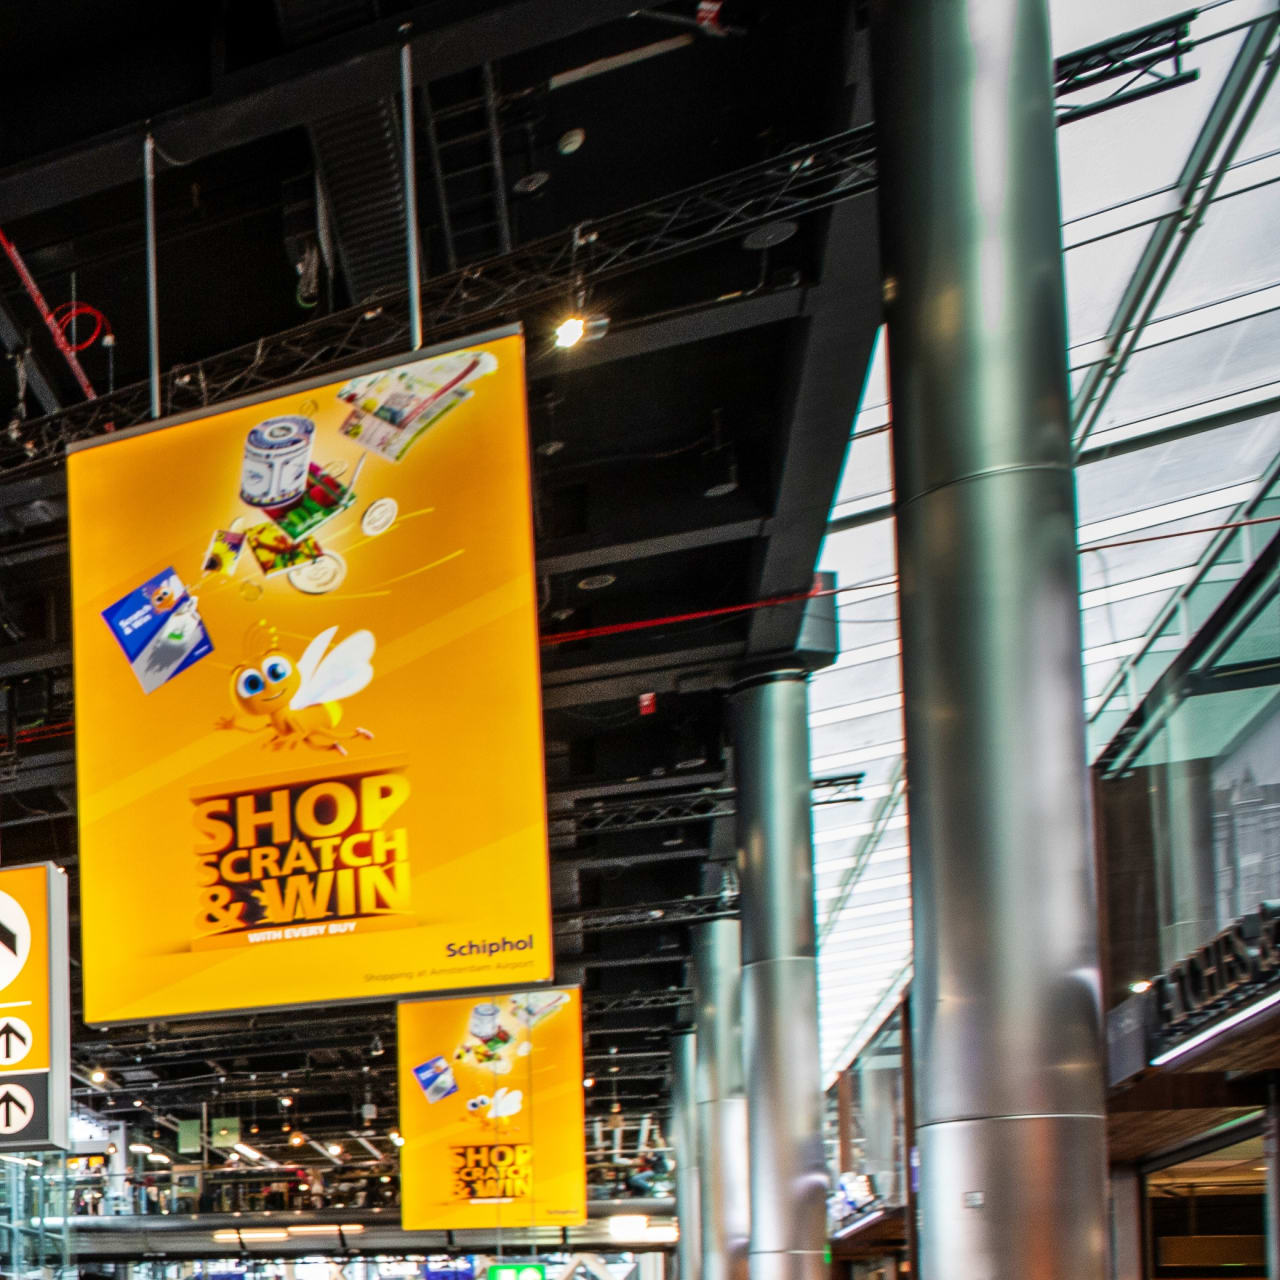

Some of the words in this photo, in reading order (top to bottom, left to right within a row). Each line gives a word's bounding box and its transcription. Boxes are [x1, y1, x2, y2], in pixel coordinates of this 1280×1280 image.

[192, 773, 411, 855] SHOP
[195, 827, 409, 887] SCRATCH
[195, 885, 245, 930] &
[252, 861, 411, 925] WIN
[248, 930, 283, 943] WITH
[284, 924, 327, 939] EVERY
[328, 921, 357, 934] BUY
[445, 934, 534, 958] Schiphol
[449, 1144, 533, 1168] SHOP
[450, 1166, 533, 1181] SCRATCH
[474, 1178, 533, 1197] WIN
